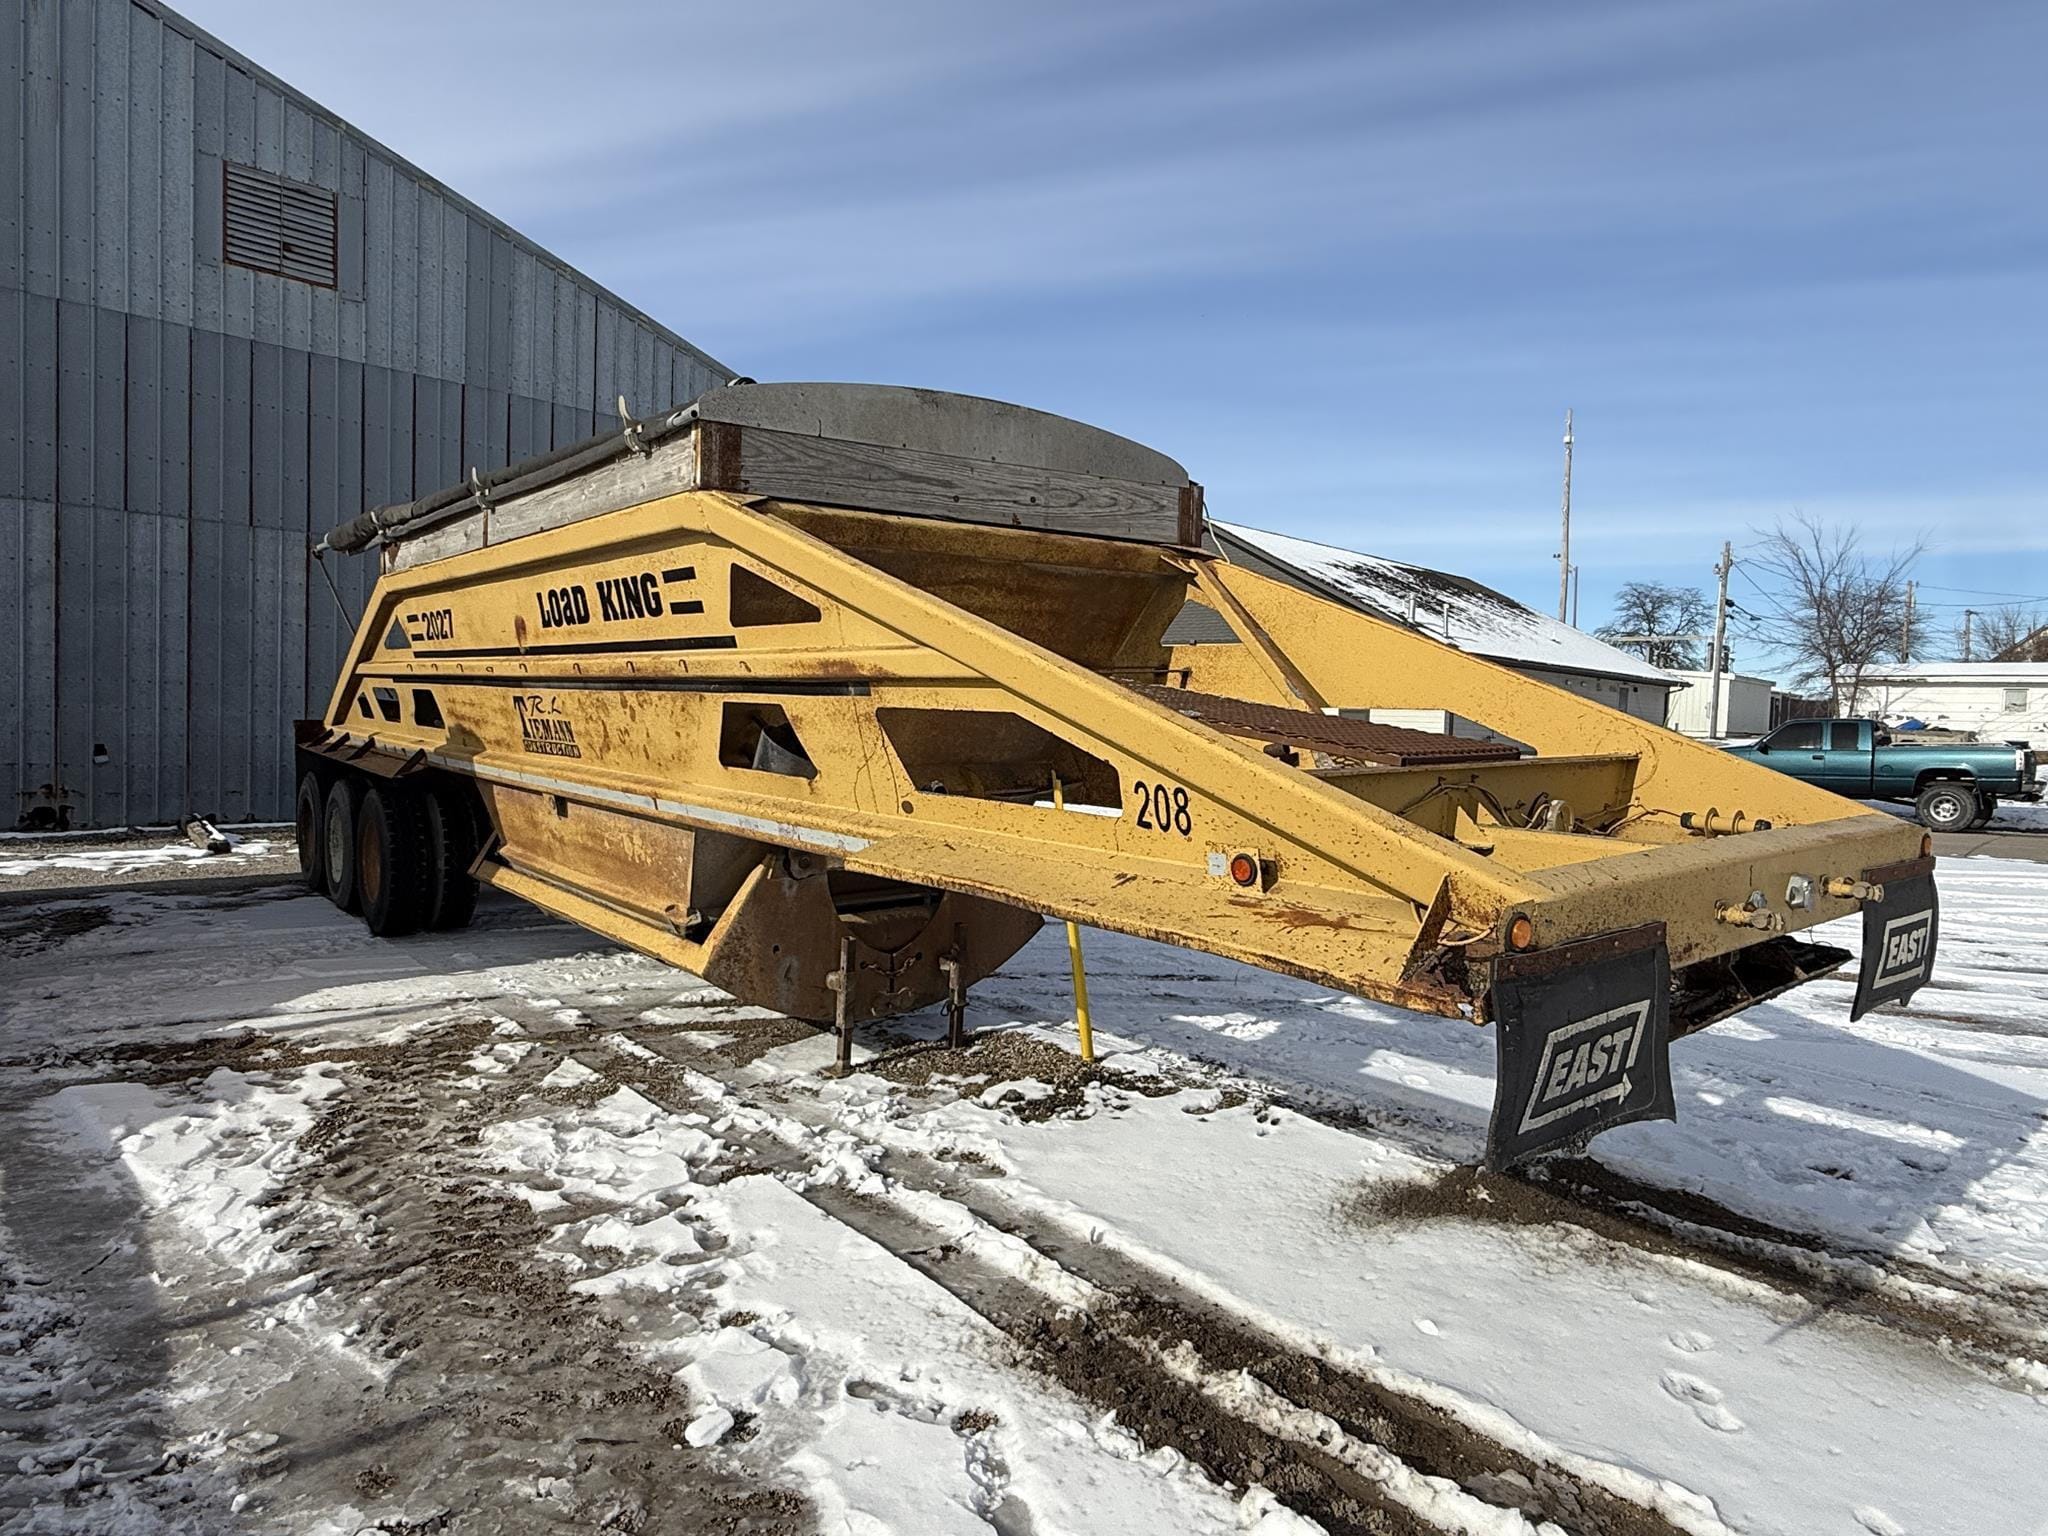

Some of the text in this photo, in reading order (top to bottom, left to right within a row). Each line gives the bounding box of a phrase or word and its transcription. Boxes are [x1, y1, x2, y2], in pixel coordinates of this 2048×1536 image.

[596, 572, 664, 622] KING
[421, 608, 454, 641] 2027
[523, 740, 581, 758] CONSTRUCTION
[1134, 780, 1192, 836] 208
[1886, 927, 1927, 970] EAST
[1542, 1026, 1634, 1102] EAST
